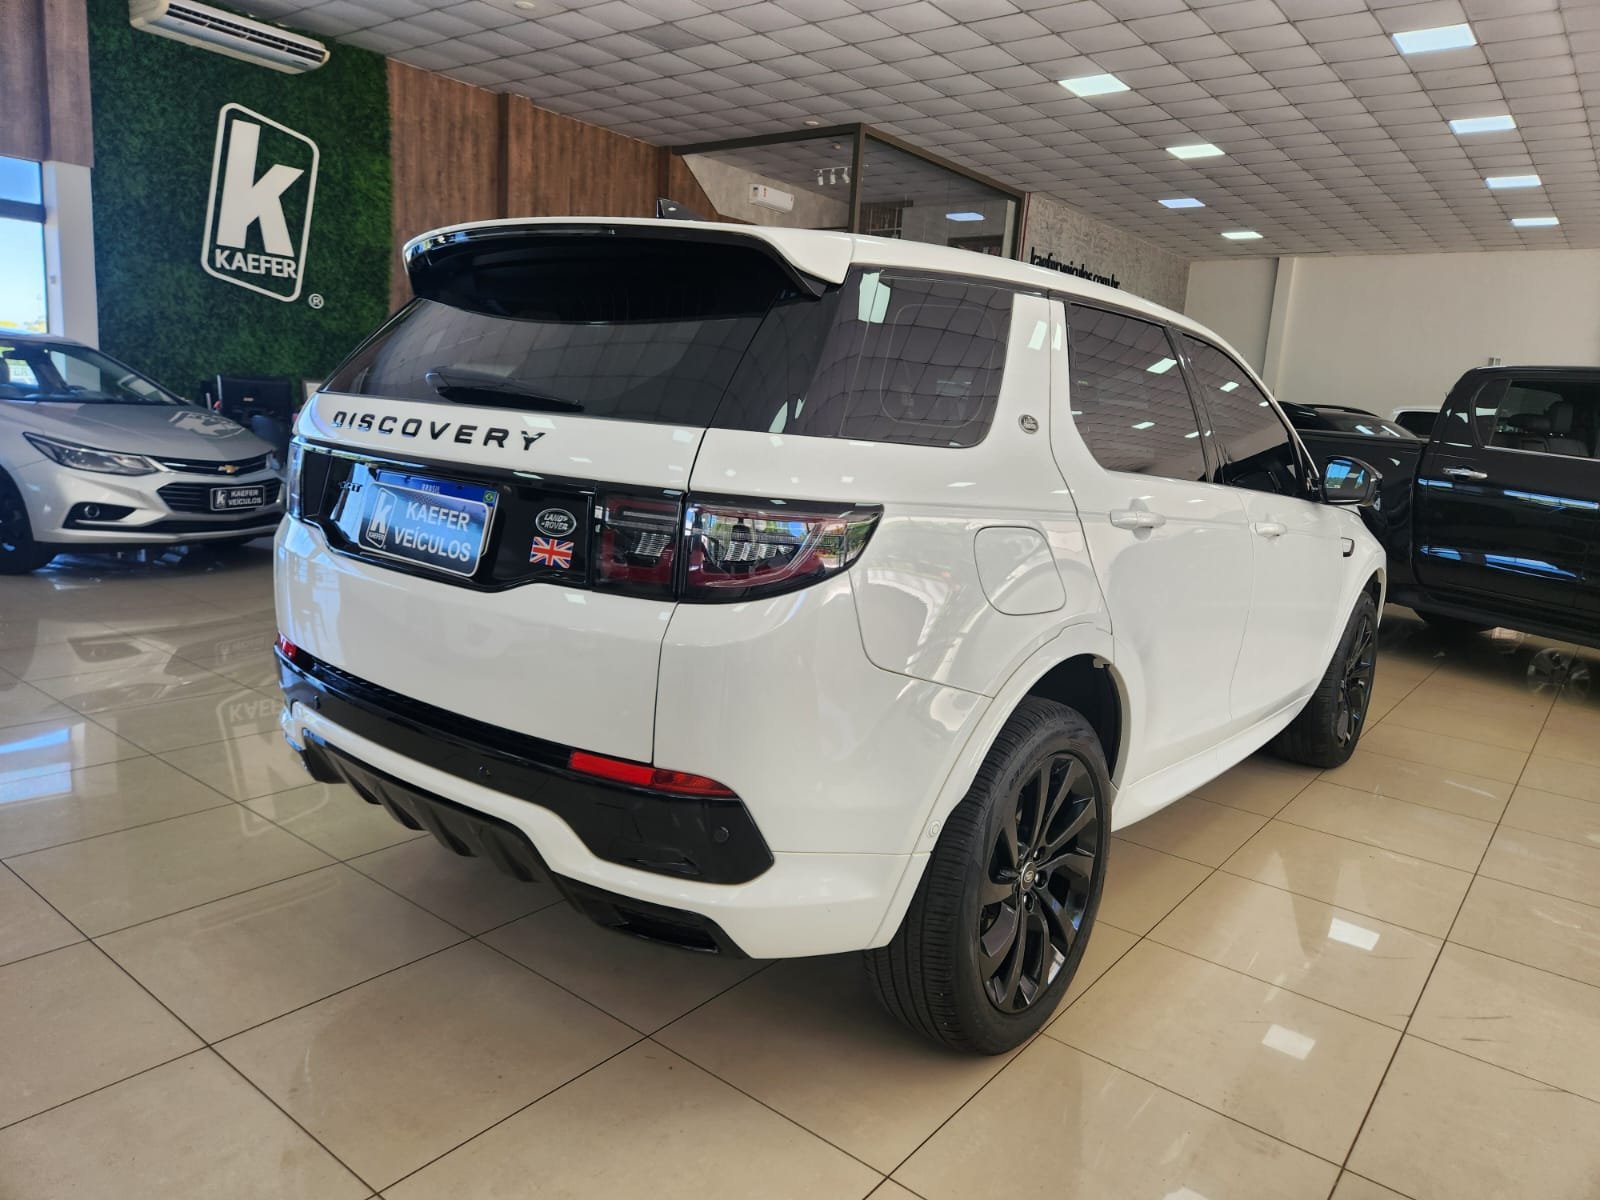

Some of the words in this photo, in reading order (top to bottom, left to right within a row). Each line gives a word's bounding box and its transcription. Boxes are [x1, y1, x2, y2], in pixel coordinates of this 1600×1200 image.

[215, 249, 297, 279] KAEFER
[332, 410, 546, 451] DISCOVERY
[230, 489, 259, 497] KAEFER
[405, 501, 470, 532] KAEFER
[544, 521, 569, 530] ROVER
[394, 524, 472, 562] VEÍCULOS
